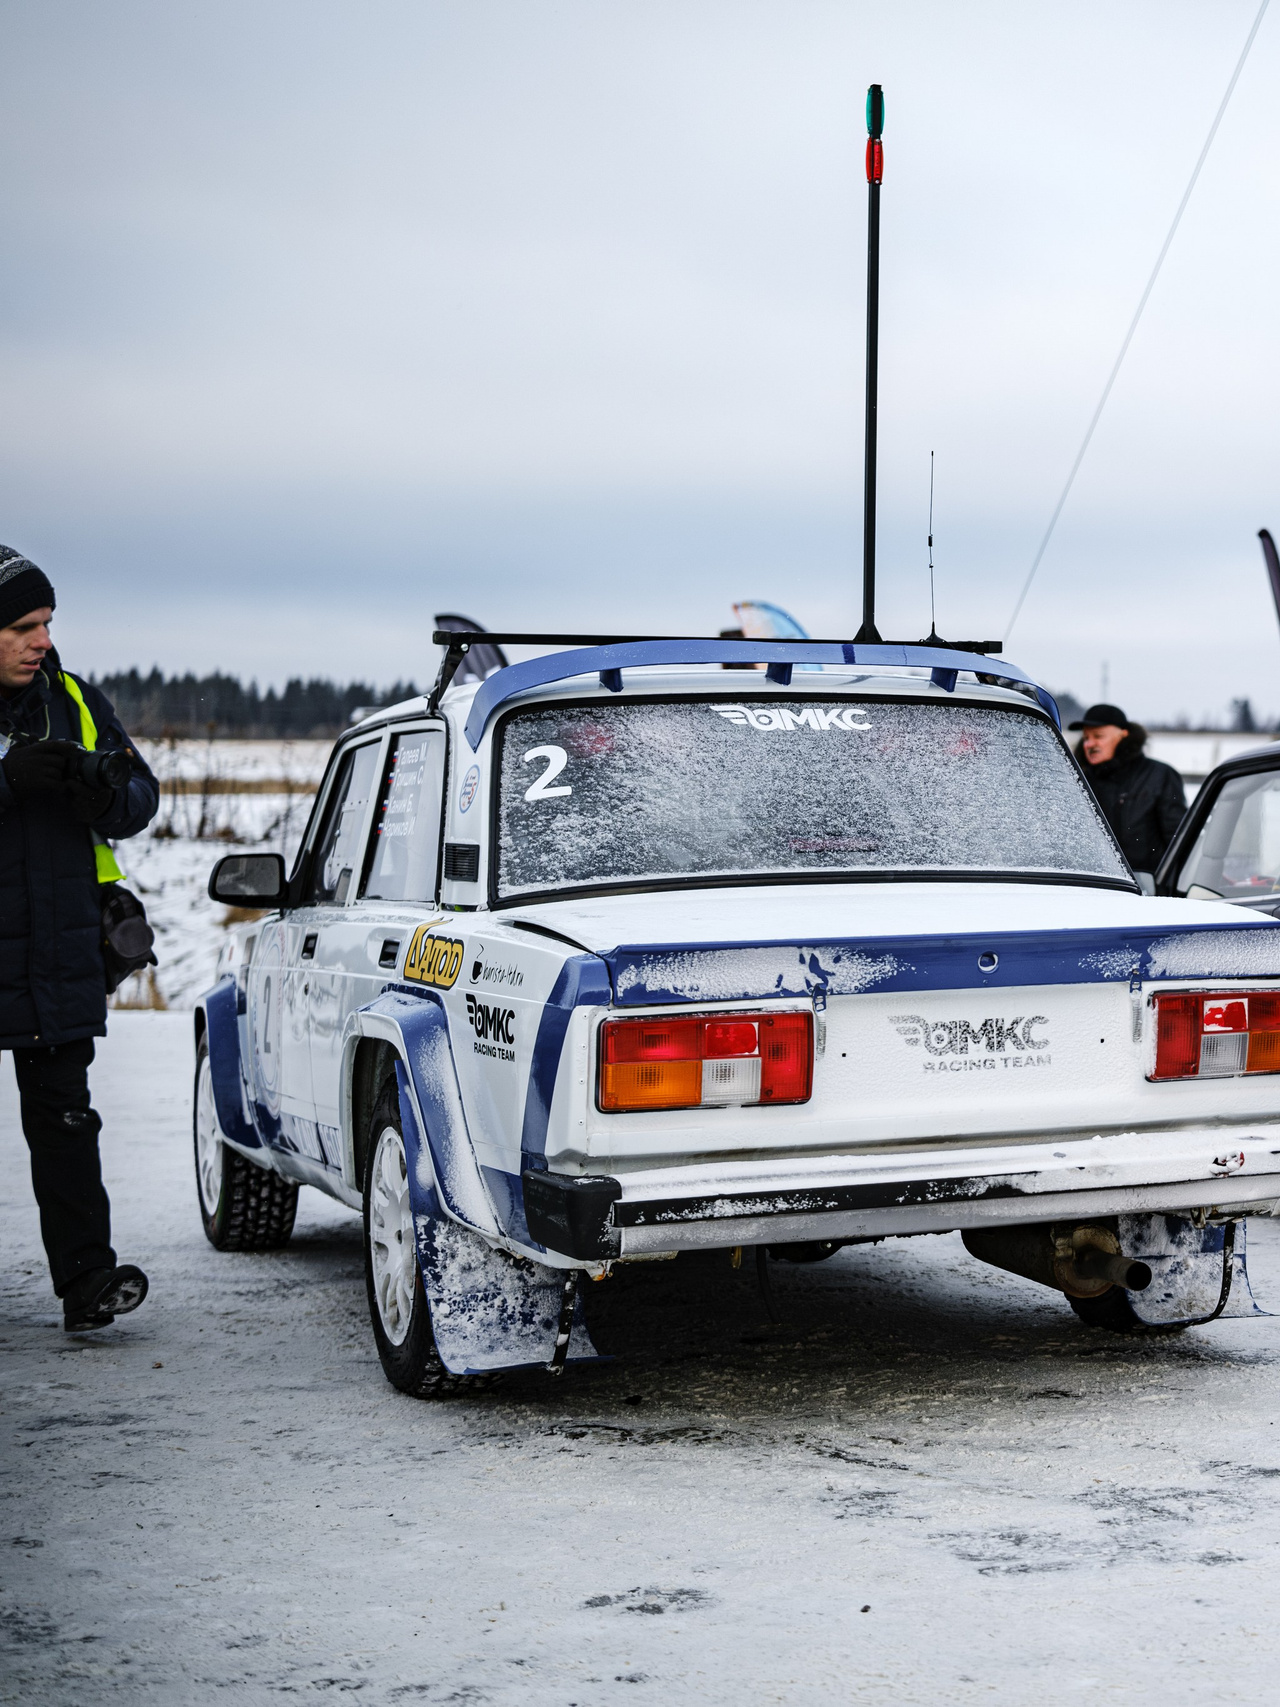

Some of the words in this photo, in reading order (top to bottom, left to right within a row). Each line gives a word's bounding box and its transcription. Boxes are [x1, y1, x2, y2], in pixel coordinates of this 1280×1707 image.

[523, 744, 573, 801] 2
[473, 1042, 497, 1058] RACING
[497, 1047, 516, 1062] TEAM
[923, 1058, 997, 1074] RACING
[1000, 1054, 1052, 1068] TEAM
